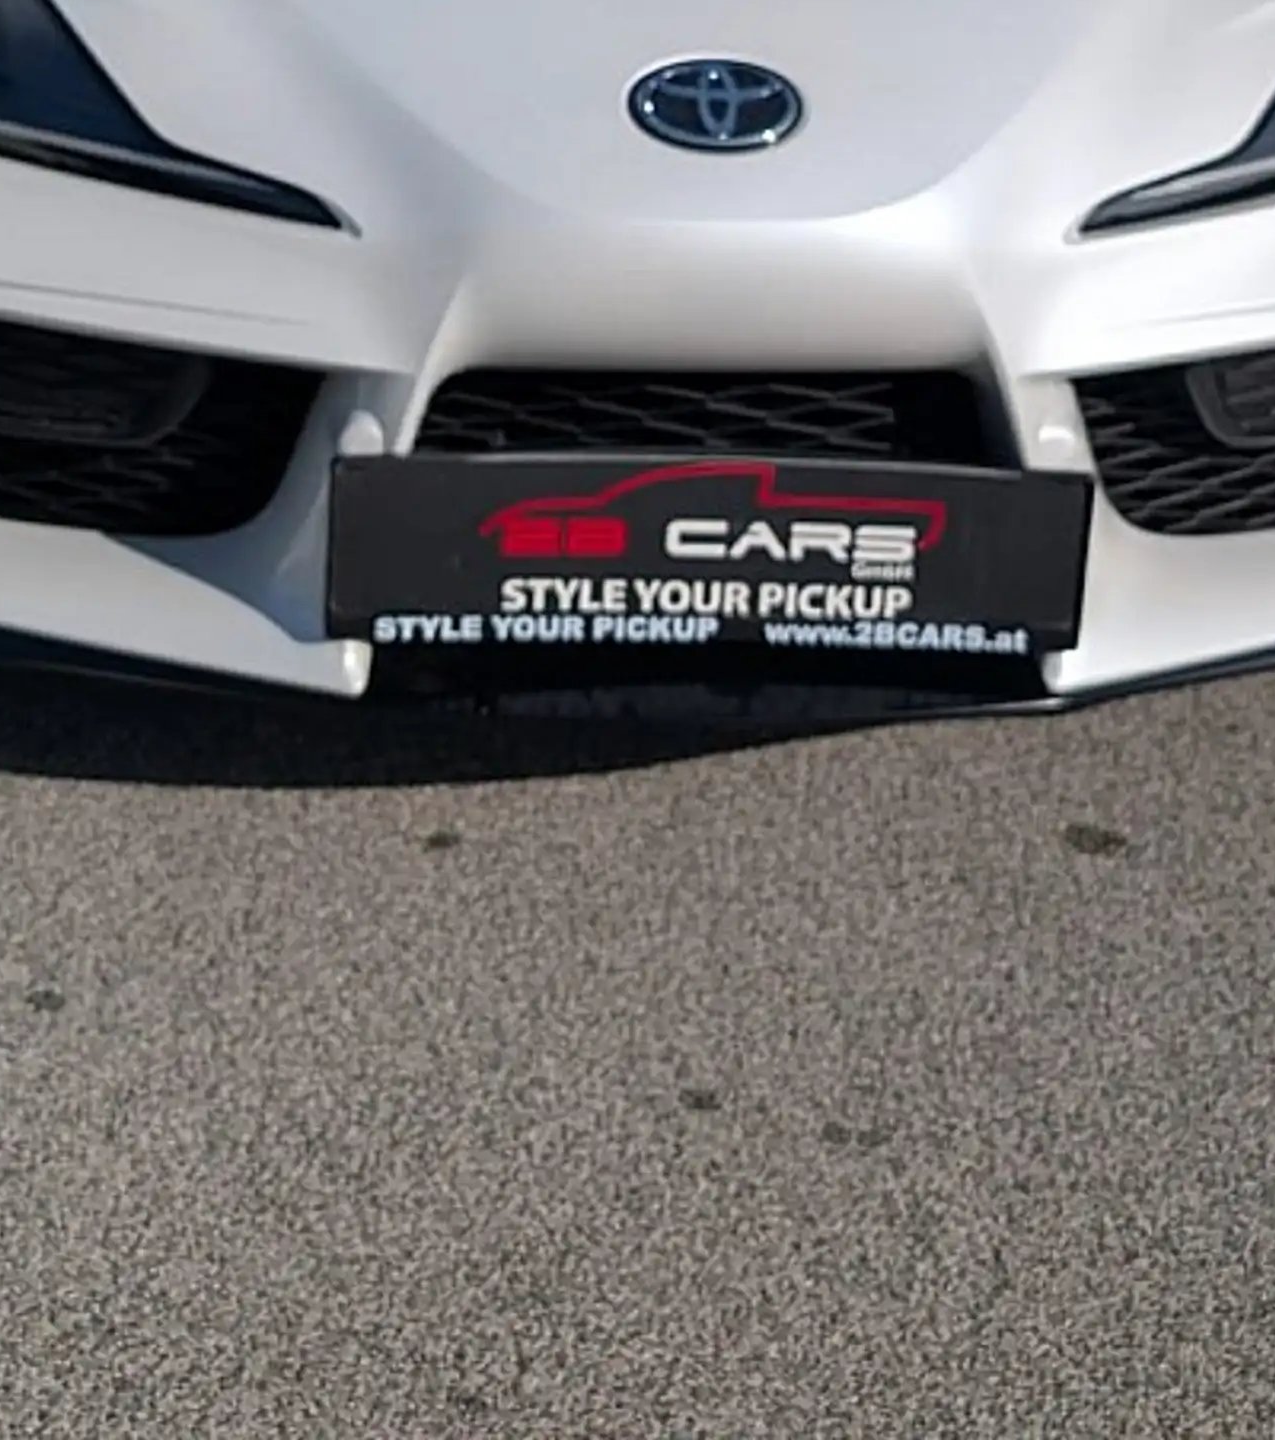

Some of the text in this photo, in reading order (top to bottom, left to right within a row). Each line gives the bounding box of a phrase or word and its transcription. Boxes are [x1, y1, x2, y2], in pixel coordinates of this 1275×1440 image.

[665, 518, 917, 563] CARS
[500, 577, 914, 621] STYLE YOUR PICKUP
[374, 613, 1030, 655] STYLE YOUR PICKUP www.2BCARS.at
